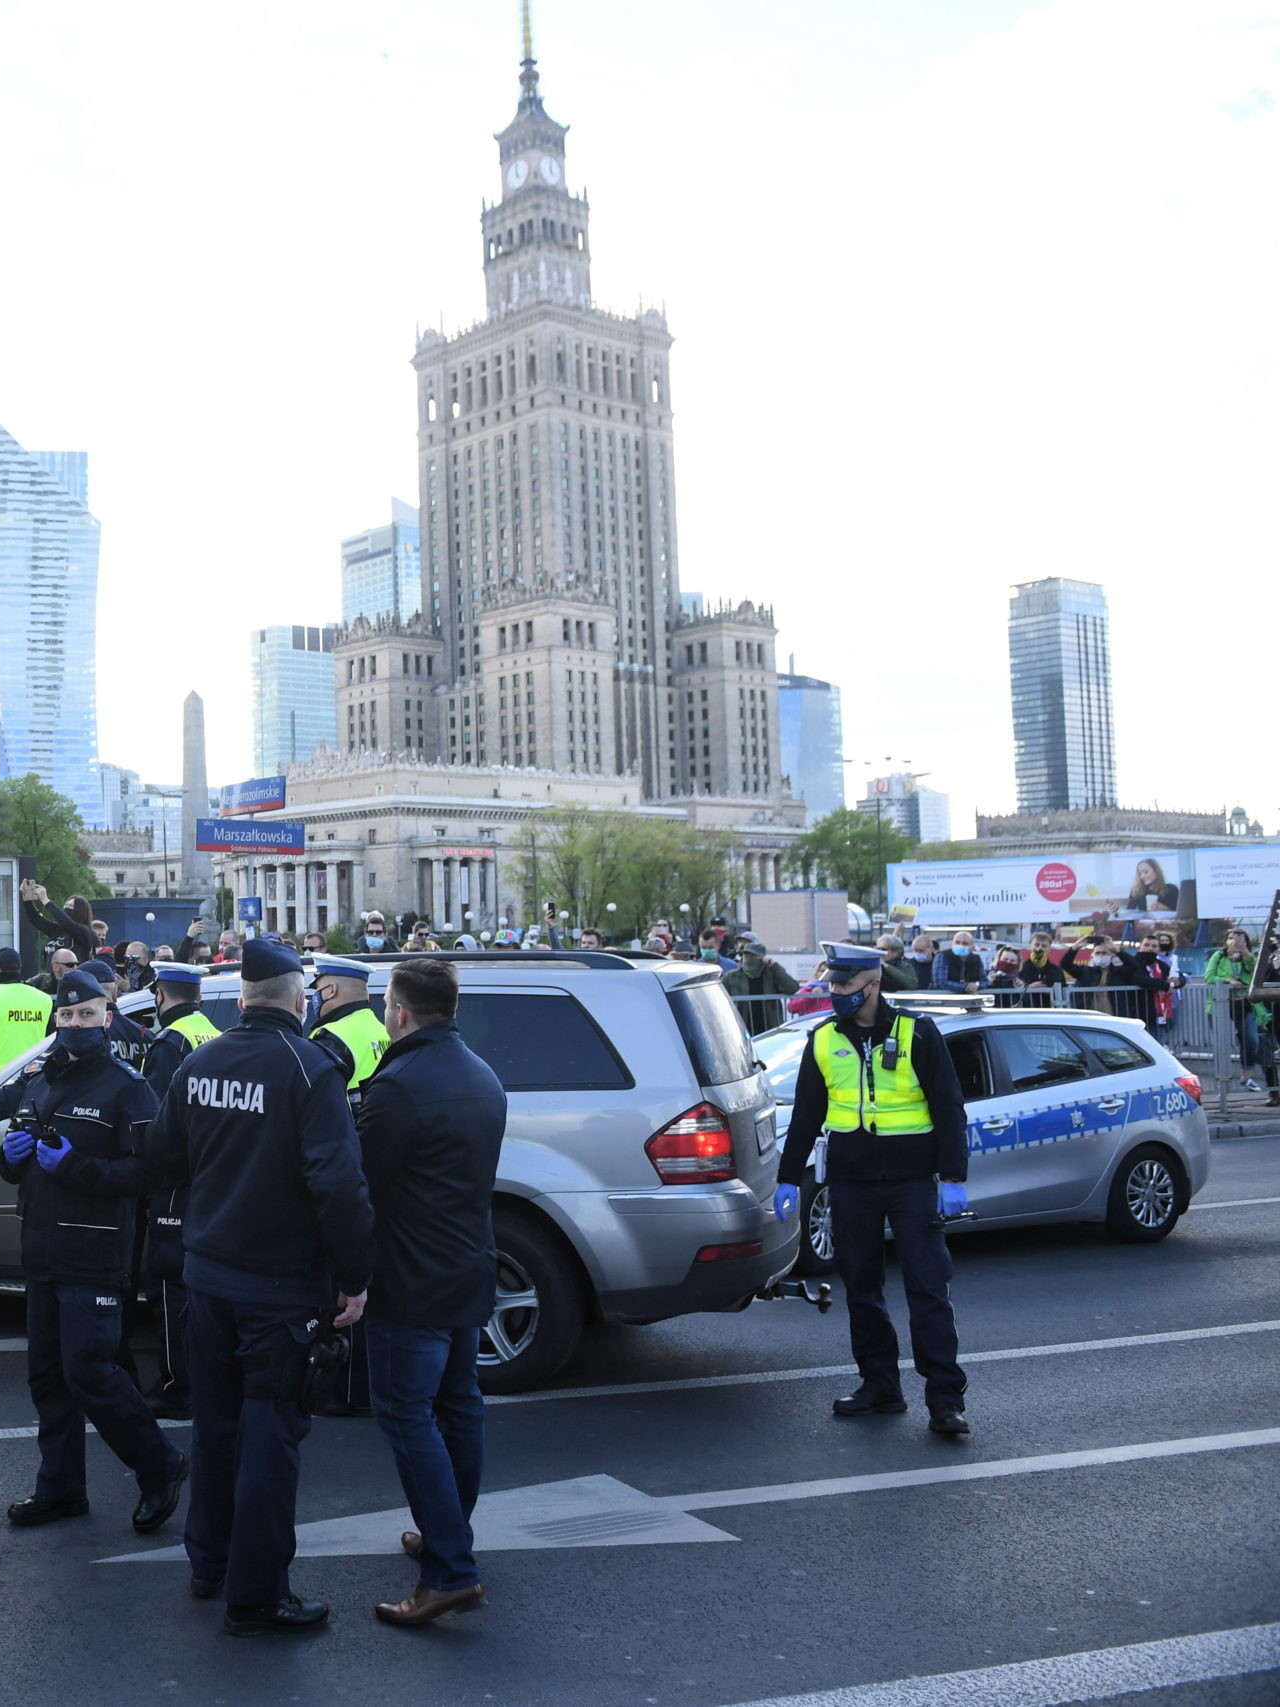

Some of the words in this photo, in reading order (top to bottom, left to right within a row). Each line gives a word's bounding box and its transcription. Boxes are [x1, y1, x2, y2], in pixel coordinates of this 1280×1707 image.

[236, 785, 280, 804] Jerozolimskie
[213, 827, 293, 844] Marszałkowska
[904, 891, 957, 908] zapisuję
[960, 890, 979, 906] się
[982, 889, 1027, 903] online
[8, 1010, 43, 1022] POLICJA
[187, 1076, 265, 1114] POLICJA
[72, 1106, 100, 1118] POLICJA
[157, 1217, 182, 1226] POLICJA
